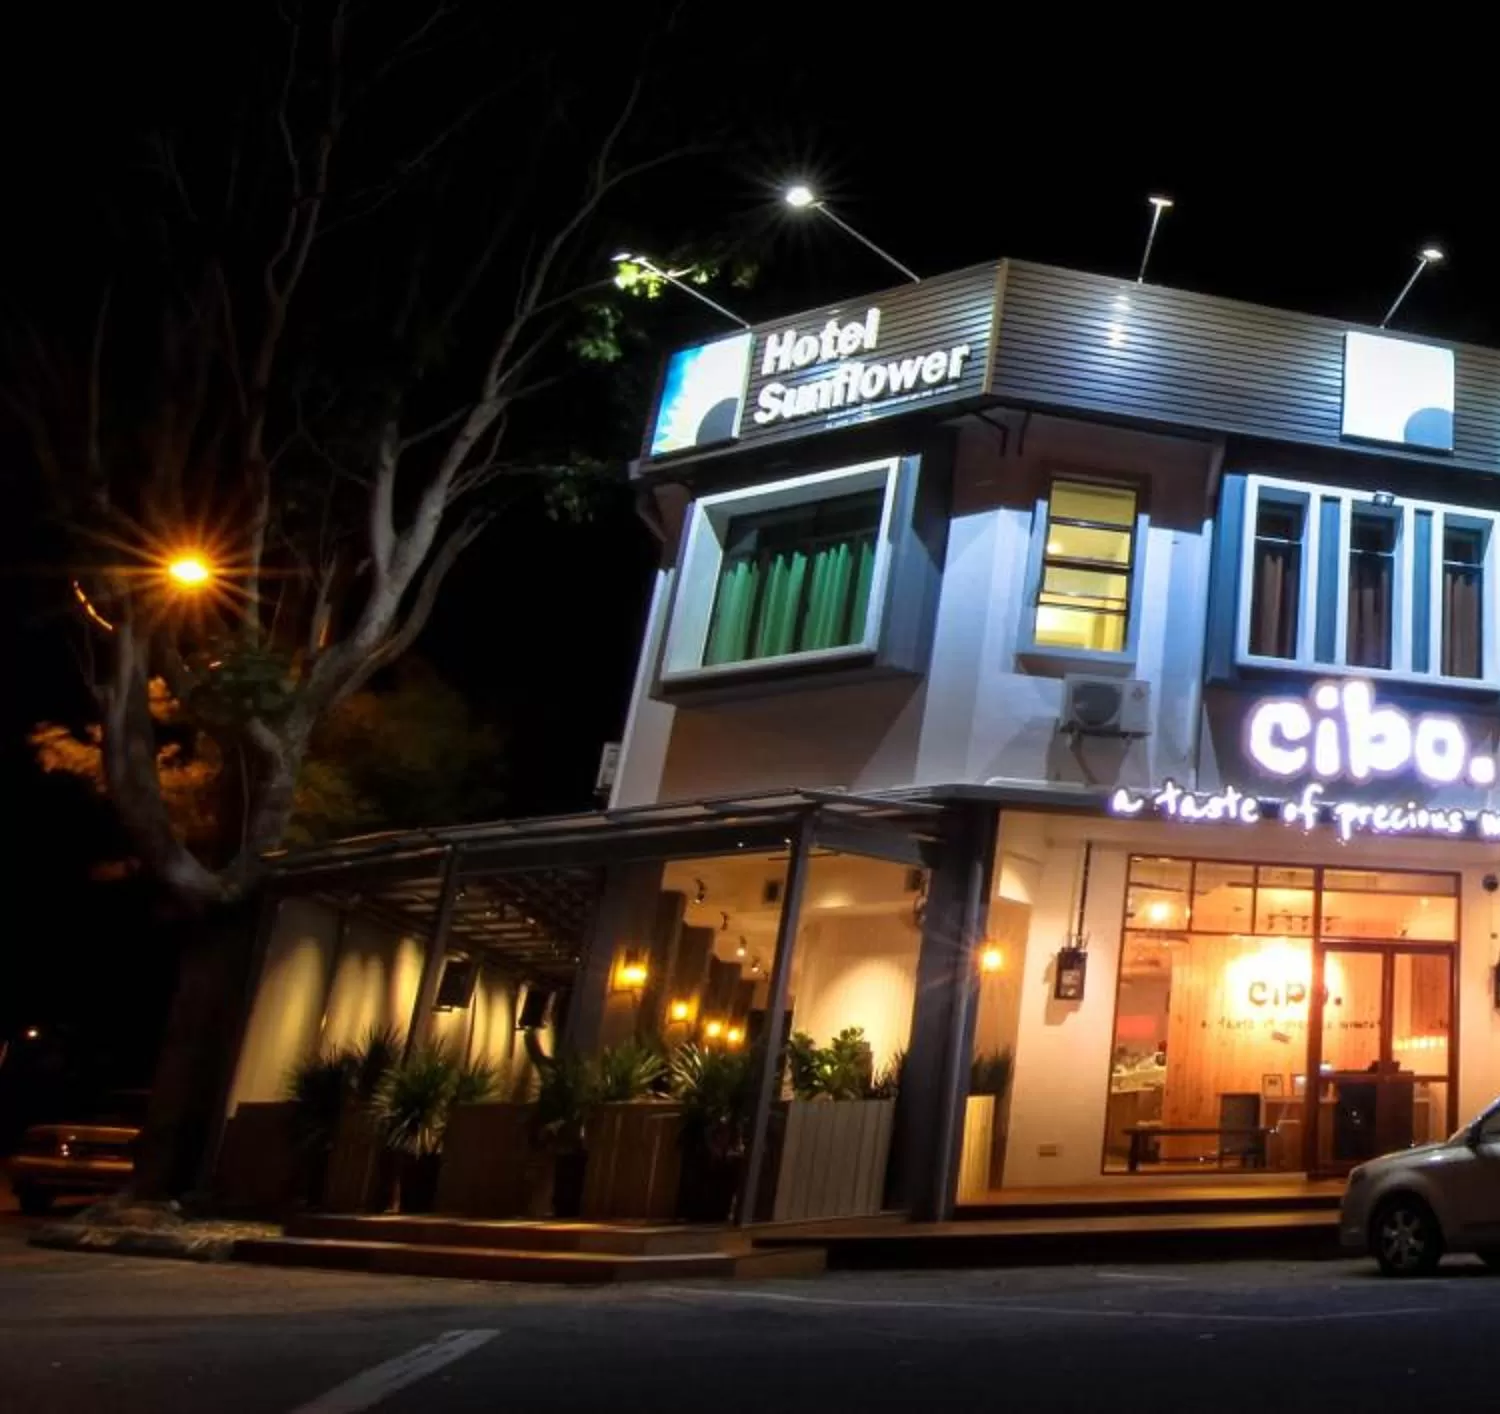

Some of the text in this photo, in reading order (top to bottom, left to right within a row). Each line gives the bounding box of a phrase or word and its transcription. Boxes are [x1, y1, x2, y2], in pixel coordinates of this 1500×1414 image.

[761, 308, 880, 375] Hotel
[754, 344, 971, 424] Sunflower
[1249, 681, 1497, 783] cibo.
[1112, 788, 1144, 813] a
[1155, 781, 1258, 823] taste
[1284, 783, 1324, 830] of
[1334, 802, 1463, 842] precious
